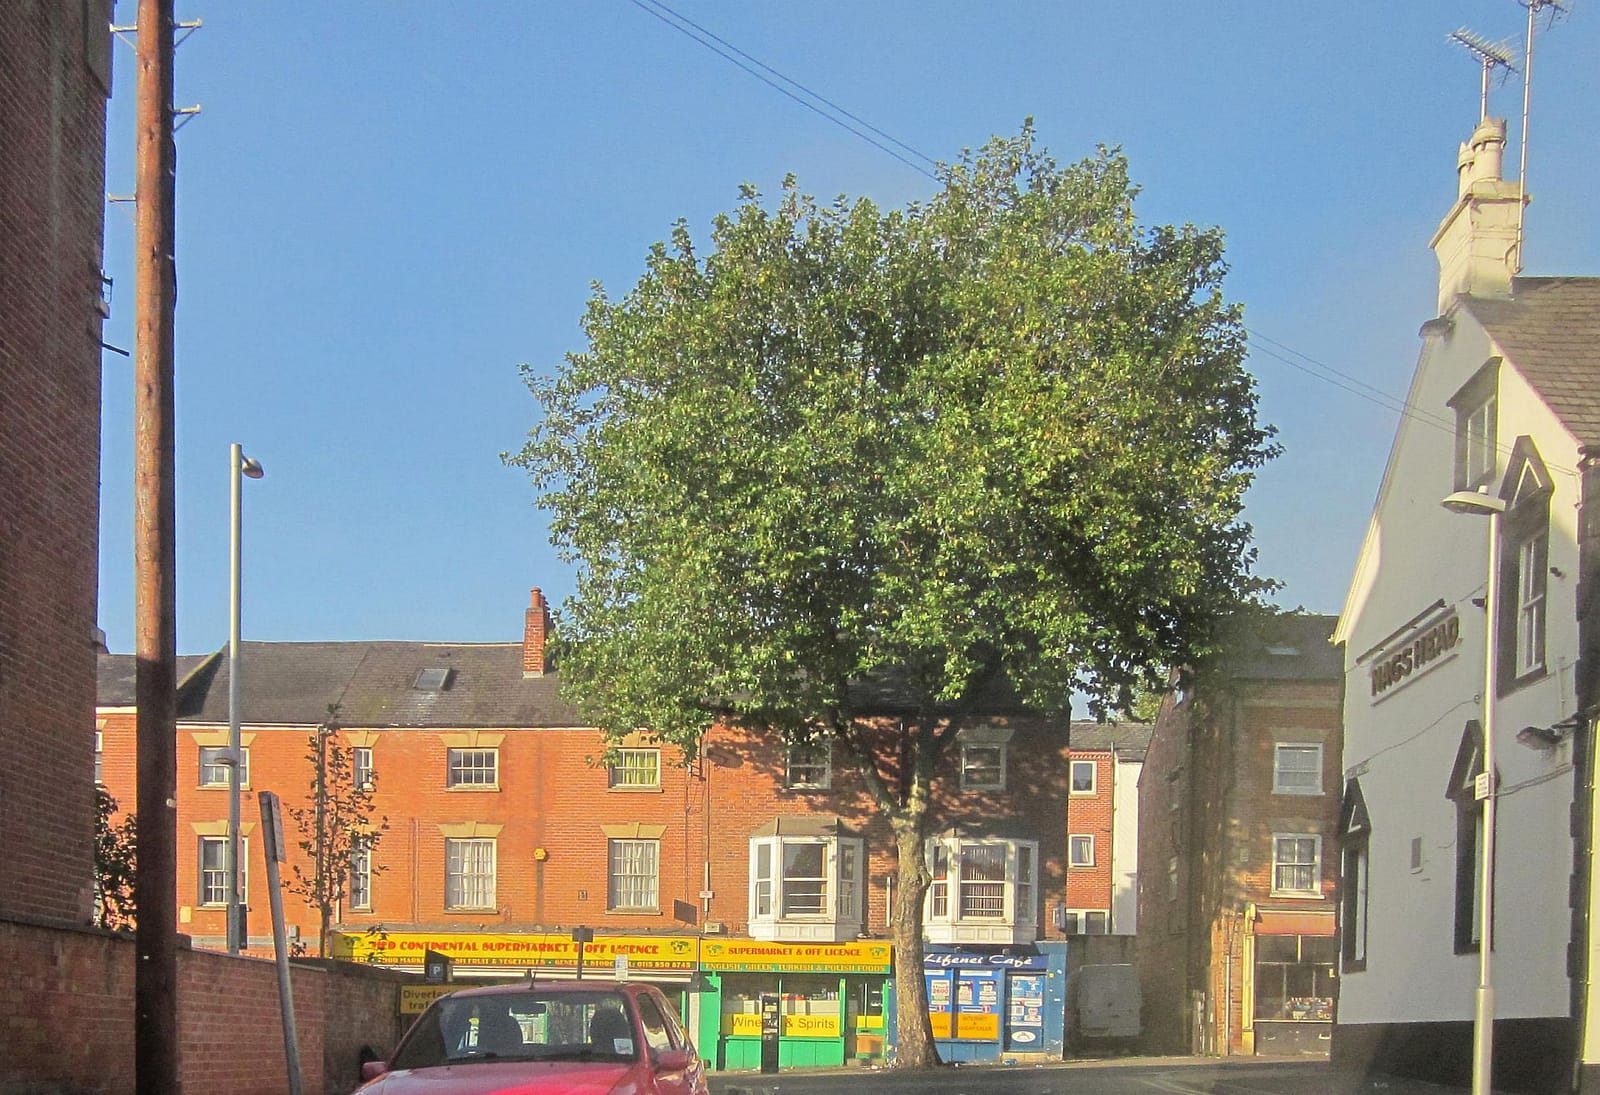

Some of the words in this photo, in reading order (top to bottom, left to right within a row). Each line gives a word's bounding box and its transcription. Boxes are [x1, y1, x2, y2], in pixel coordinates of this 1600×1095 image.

[1371, 648, 1413, 696] NAGS
[1414, 616, 1459, 669] HEAD
[399, 941, 478, 951] CONTINENTAL
[482, 942, 568, 953] SUPERMARKET
[584, 944, 607, 954] OFF
[610, 945, 659, 955] LICENCE
[728, 947, 793, 956] SUPERMARKET
[796, 948, 803, 956] &
[805, 948, 821, 957] OFF
[824, 948, 862, 957] LICENCE
[400, 957, 426, 966] MARKE
[403, 989, 451, 998] Diverte
[731, 1016, 762, 1028] Wine
[784, 1017, 794, 1028] &
[798, 1017, 835, 1030] Spirits
